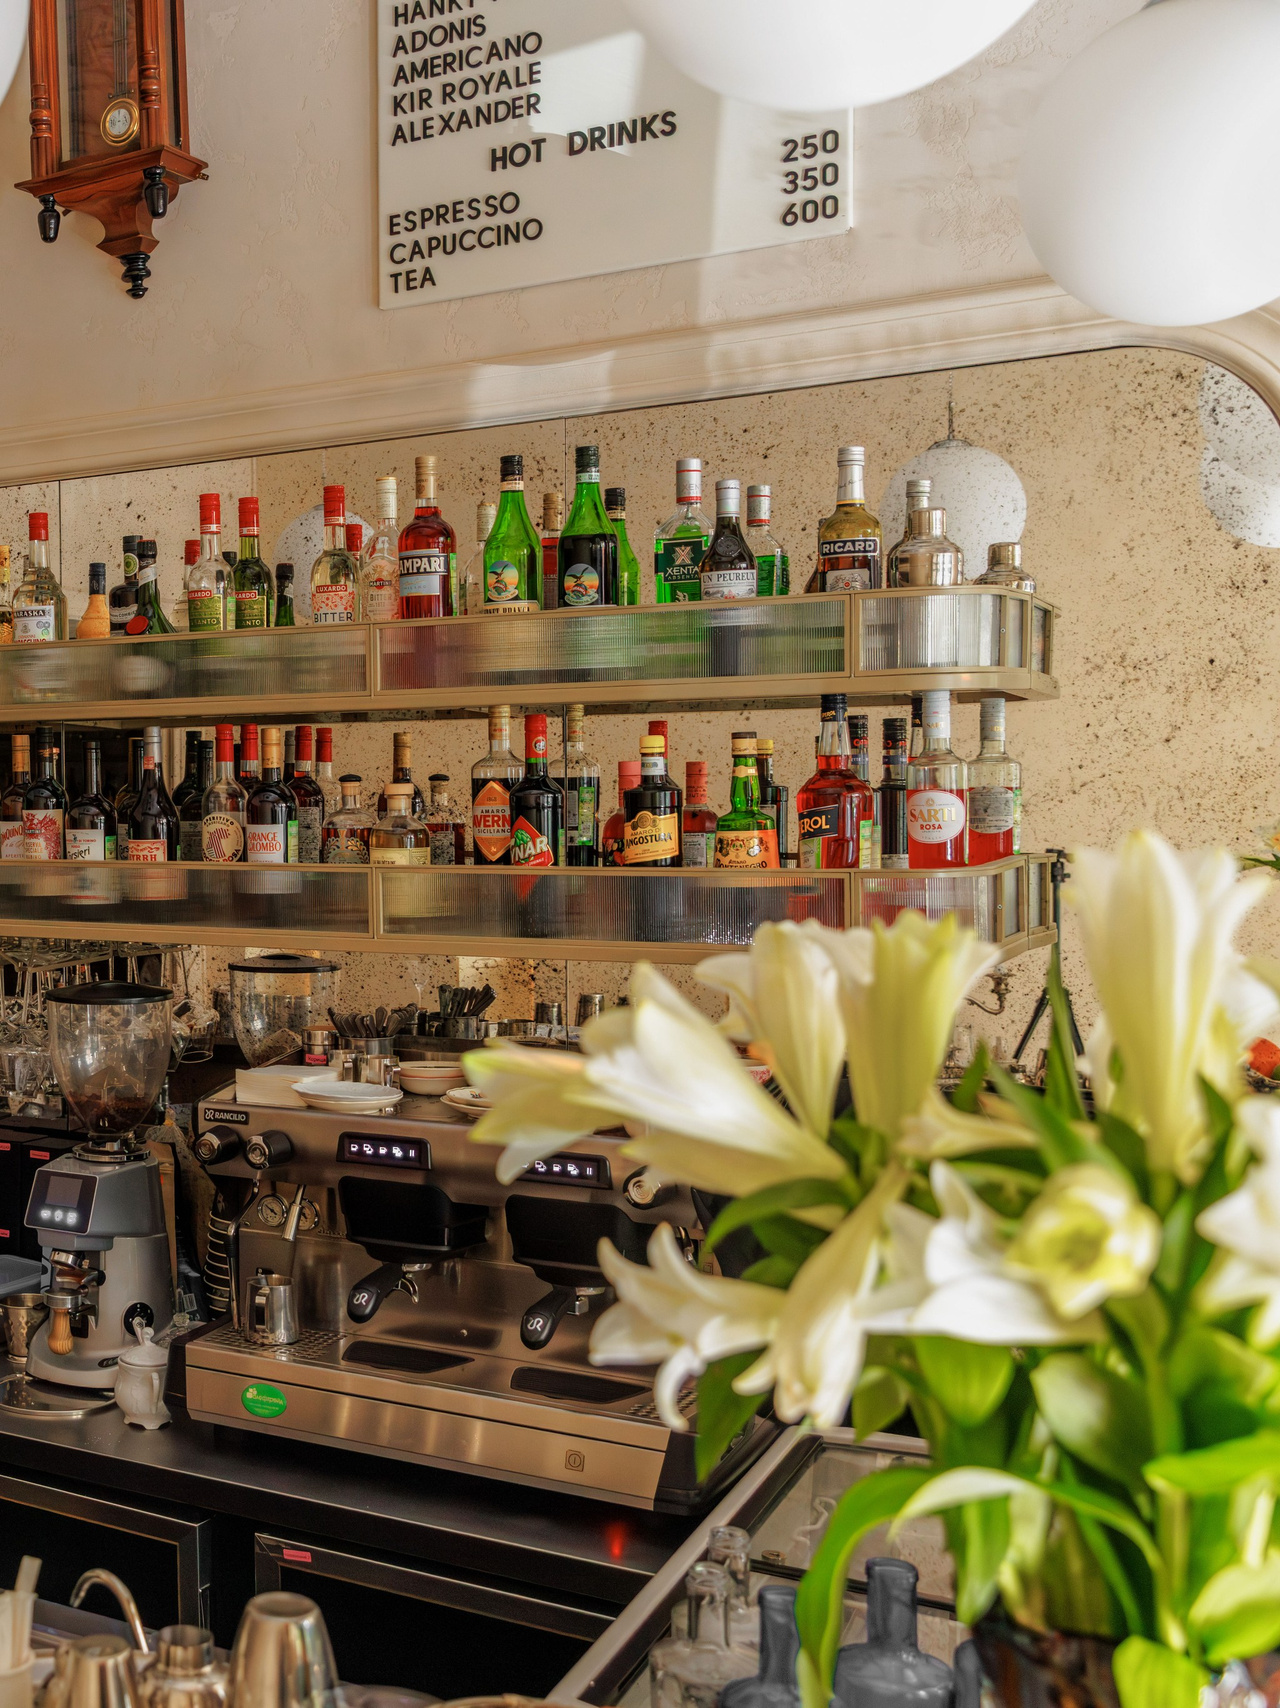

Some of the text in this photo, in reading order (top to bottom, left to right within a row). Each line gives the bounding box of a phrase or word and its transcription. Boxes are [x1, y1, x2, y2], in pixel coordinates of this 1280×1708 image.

[392, 14, 487, 58] ADONIS
[393, 31, 543, 88] AMERICANO
[393, 61, 542, 118] KIR ROYALE
[391, 93, 542, 147] ALEXANDER
[490, 110, 677, 172] HOT DRINKS
[782, 129, 839, 163] 250
[783, 162, 839, 195] 350
[389, 191, 520, 236] ESPRESSO
[782, 194, 839, 227] 600
[390, 217, 544, 266] CAPUCCINO
[390, 266, 437, 294] TEA
[822, 541, 875, 554] RICARD
[400, 556, 445, 574] AMPARI
[666, 565, 700, 577] XENTA
[702, 571, 755, 583] UN PEUREUX
[317, 585, 347, 593] LUXARDO
[314, 611, 353, 624] BITTER
[203, 814, 235, 827] APERITIVO
[473, 814, 511, 828] AVERN
[909, 807, 957, 822] SARTI
[630, 828, 653, 837] AMARO
[800, 815, 831, 834] EROL
[919, 823, 943, 831] ROSA
[510, 835, 548, 864] YNAR
[625, 832, 673, 849] ANGOSTURA
[214, 1111, 246, 1121] RANCILIO
